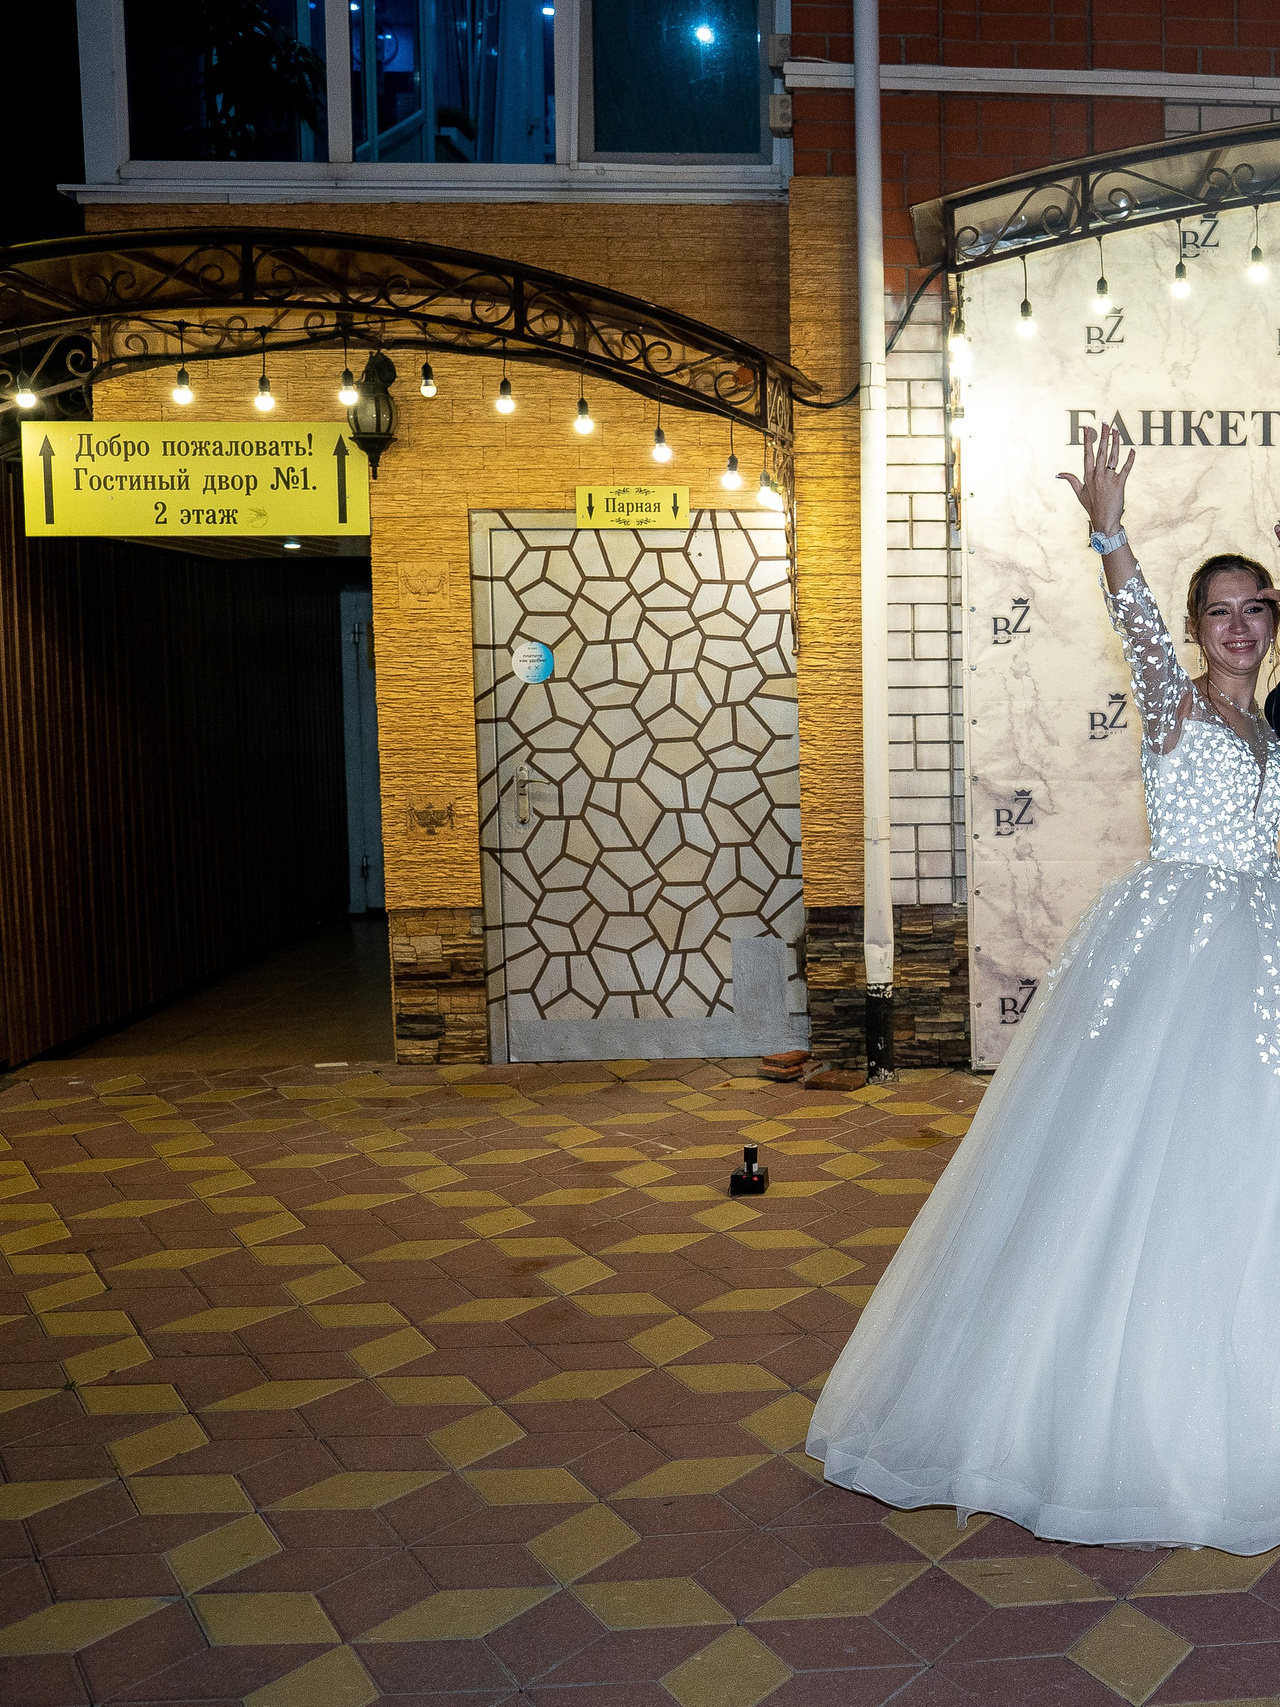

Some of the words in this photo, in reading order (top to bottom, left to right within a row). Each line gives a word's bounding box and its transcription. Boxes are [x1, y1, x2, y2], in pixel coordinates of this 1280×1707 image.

[75, 433, 150, 463] Добро
[162, 433, 313, 457] пожаловать!
[73, 467, 190, 492] Гостиный
[202, 475, 258, 496] двор
[270, 467, 317, 492] №1.
[154, 501, 168, 525] 2
[180, 509, 238, 525] этаж
[605, 498, 661, 516] Парная
